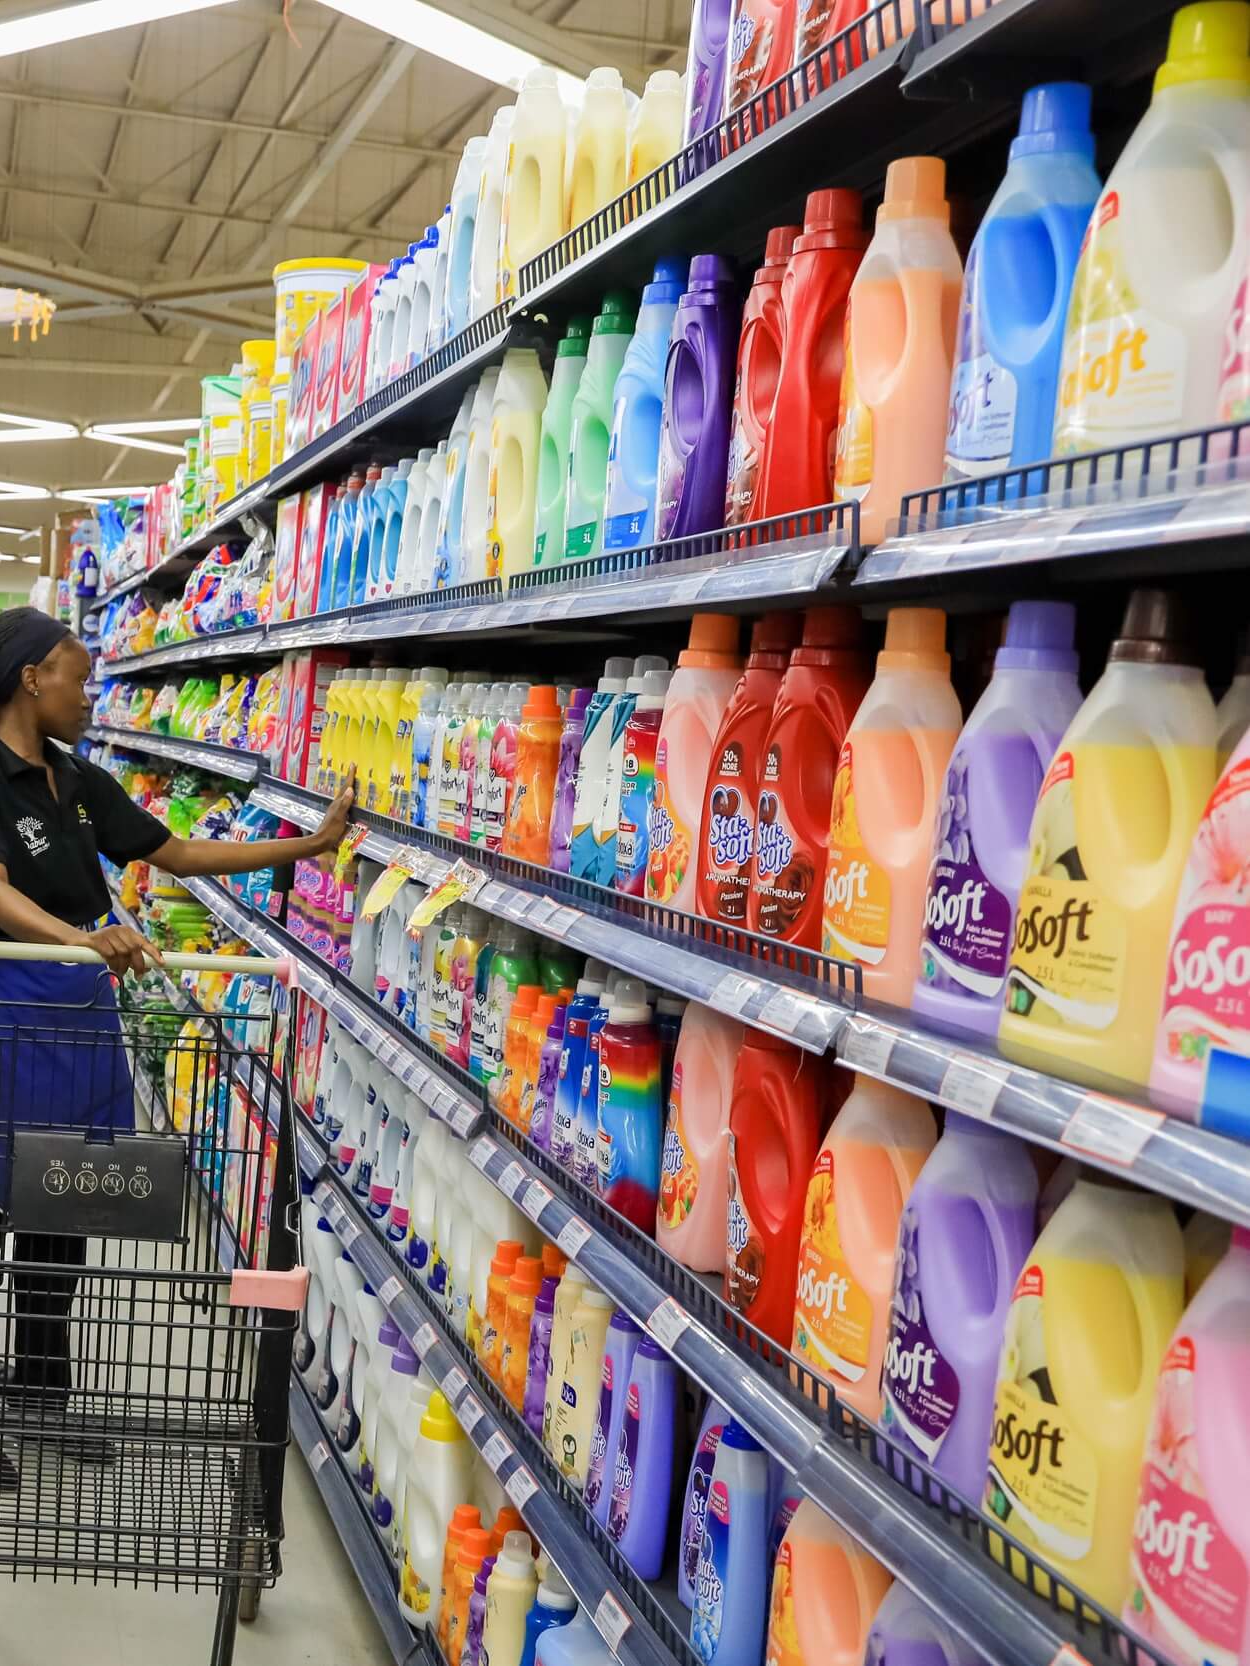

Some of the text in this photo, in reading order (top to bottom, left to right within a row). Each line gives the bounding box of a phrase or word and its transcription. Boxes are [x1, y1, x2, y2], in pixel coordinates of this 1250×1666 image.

[625, 759, 634, 769] 18
[721, 762, 738, 771] MORE
[1169, 935, 1250, 997] SoSo
[81, 1161, 94, 1169] NO
